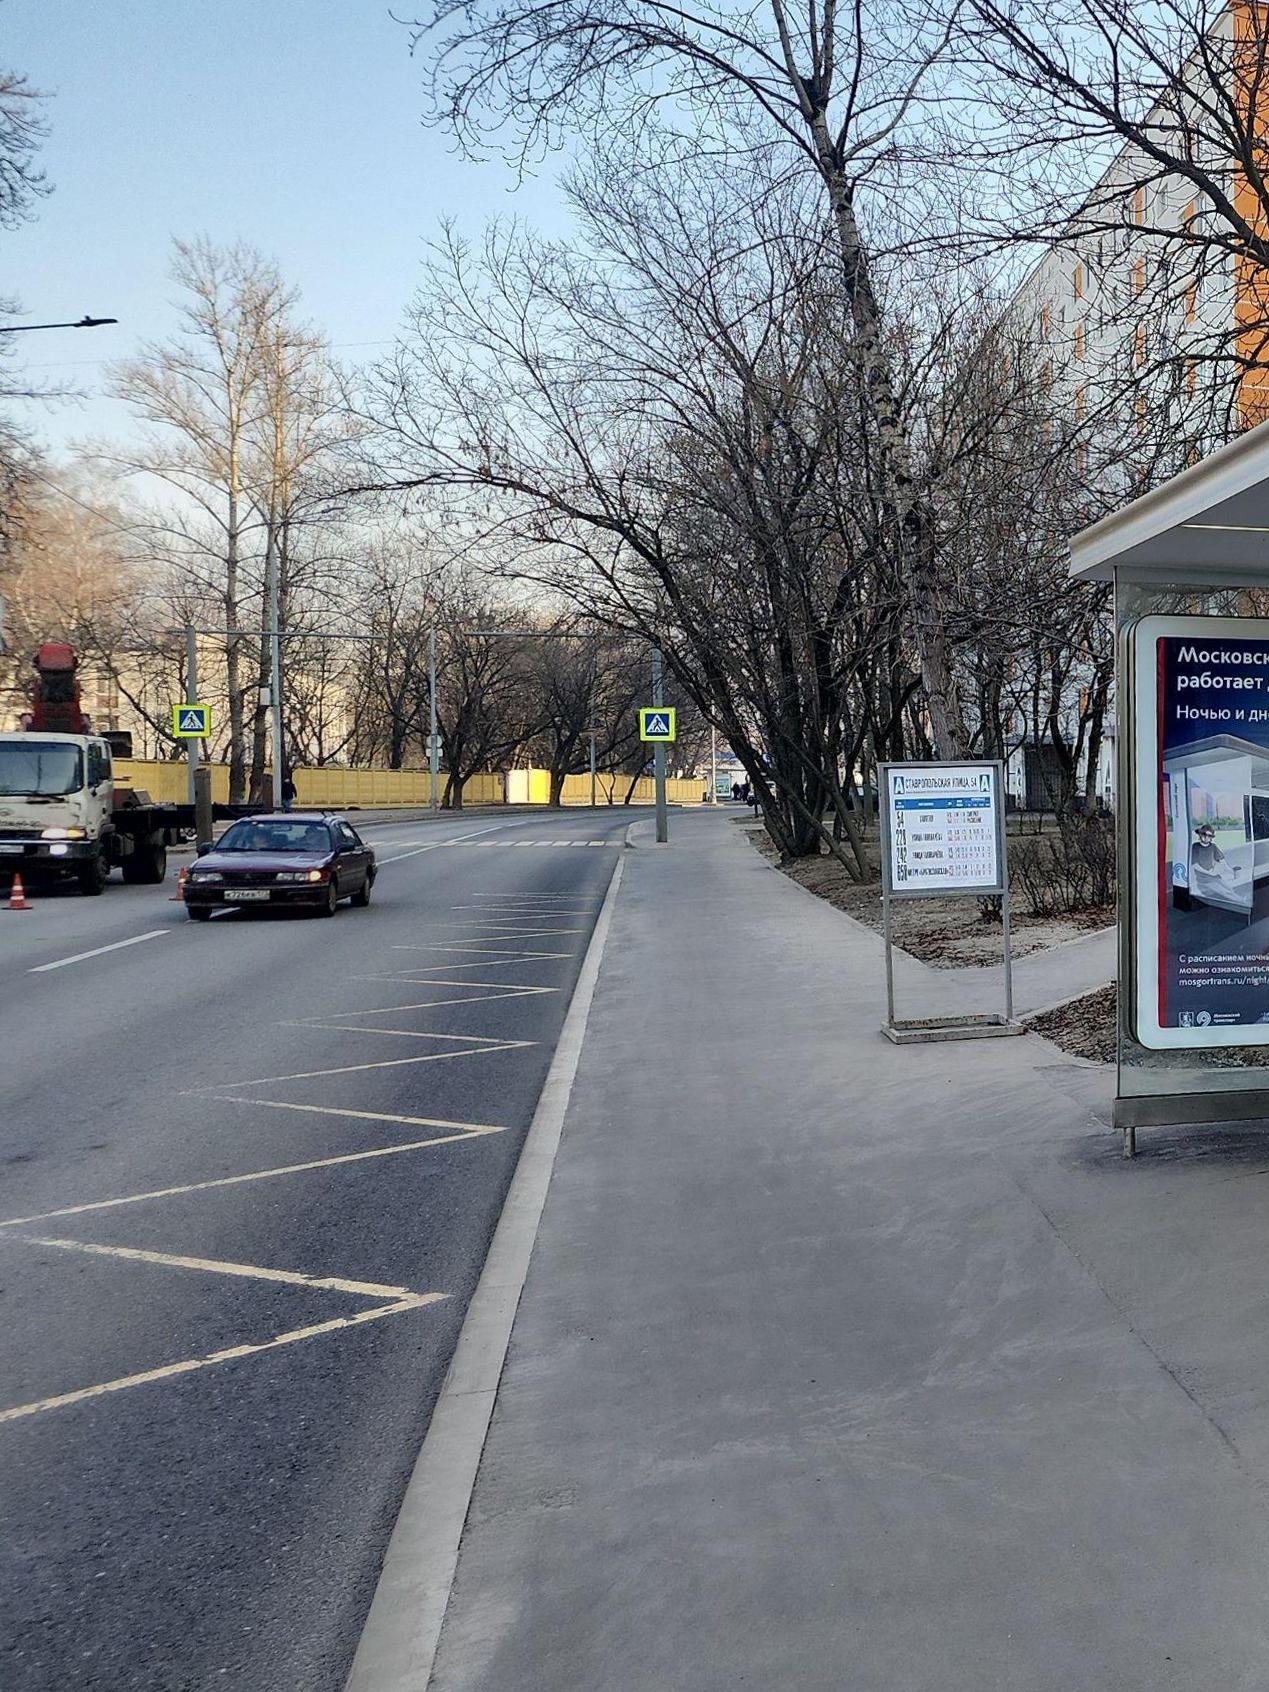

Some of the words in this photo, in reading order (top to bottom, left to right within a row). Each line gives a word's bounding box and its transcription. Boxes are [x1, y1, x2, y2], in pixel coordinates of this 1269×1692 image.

[1177, 672, 1263, 691] работает
[1176, 705, 1230, 720] Ночью
[1235, 709, 1244, 720] и
[1179, 955, 1185, 963] С
[1188, 955, 1244, 964] расписанием
[1211, 966, 1269, 974] ознакомиться
